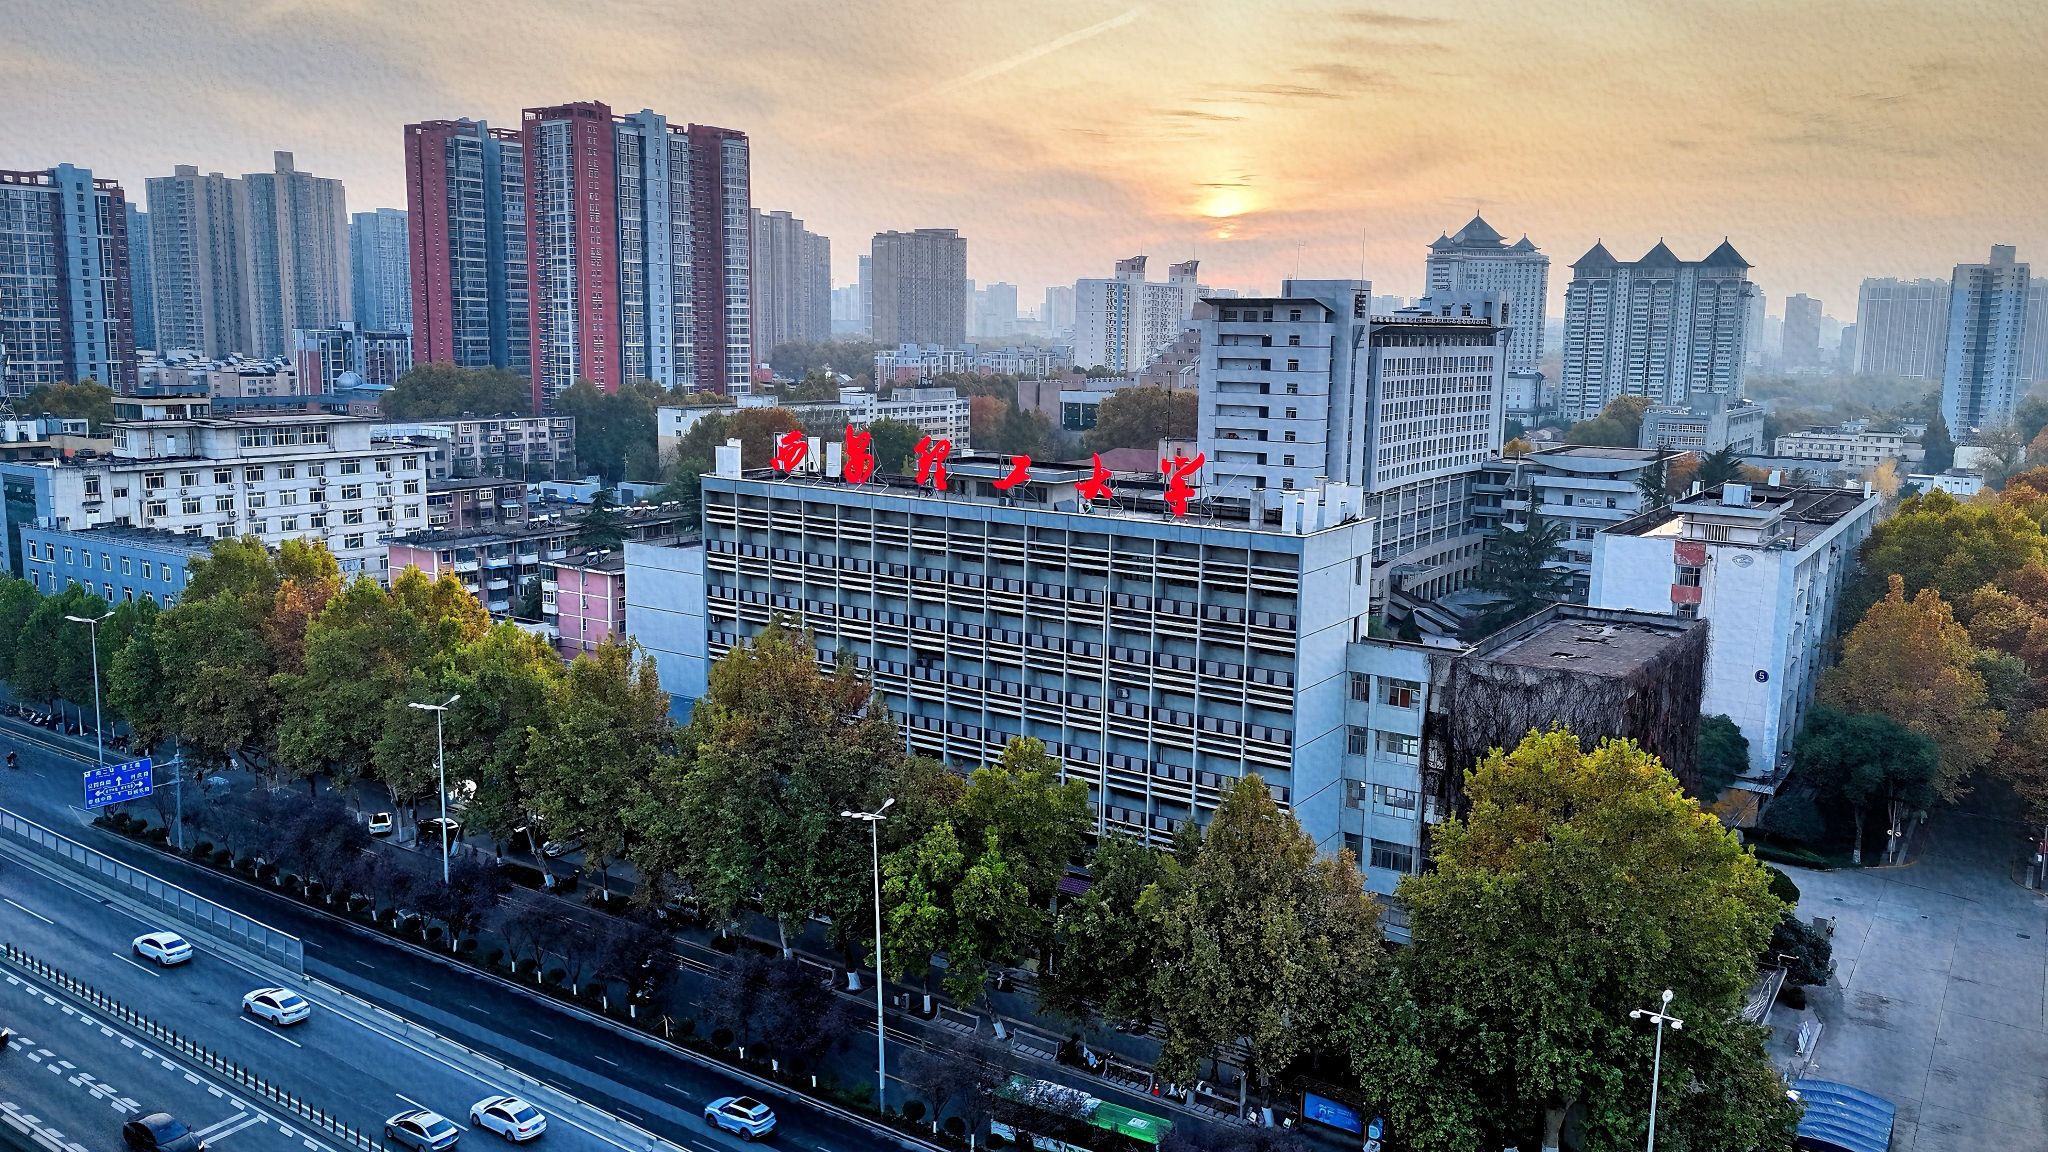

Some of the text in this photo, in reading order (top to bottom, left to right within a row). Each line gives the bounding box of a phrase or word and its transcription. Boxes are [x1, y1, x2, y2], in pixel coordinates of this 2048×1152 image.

[770, 425, 1205, 517] 西安理工大学
